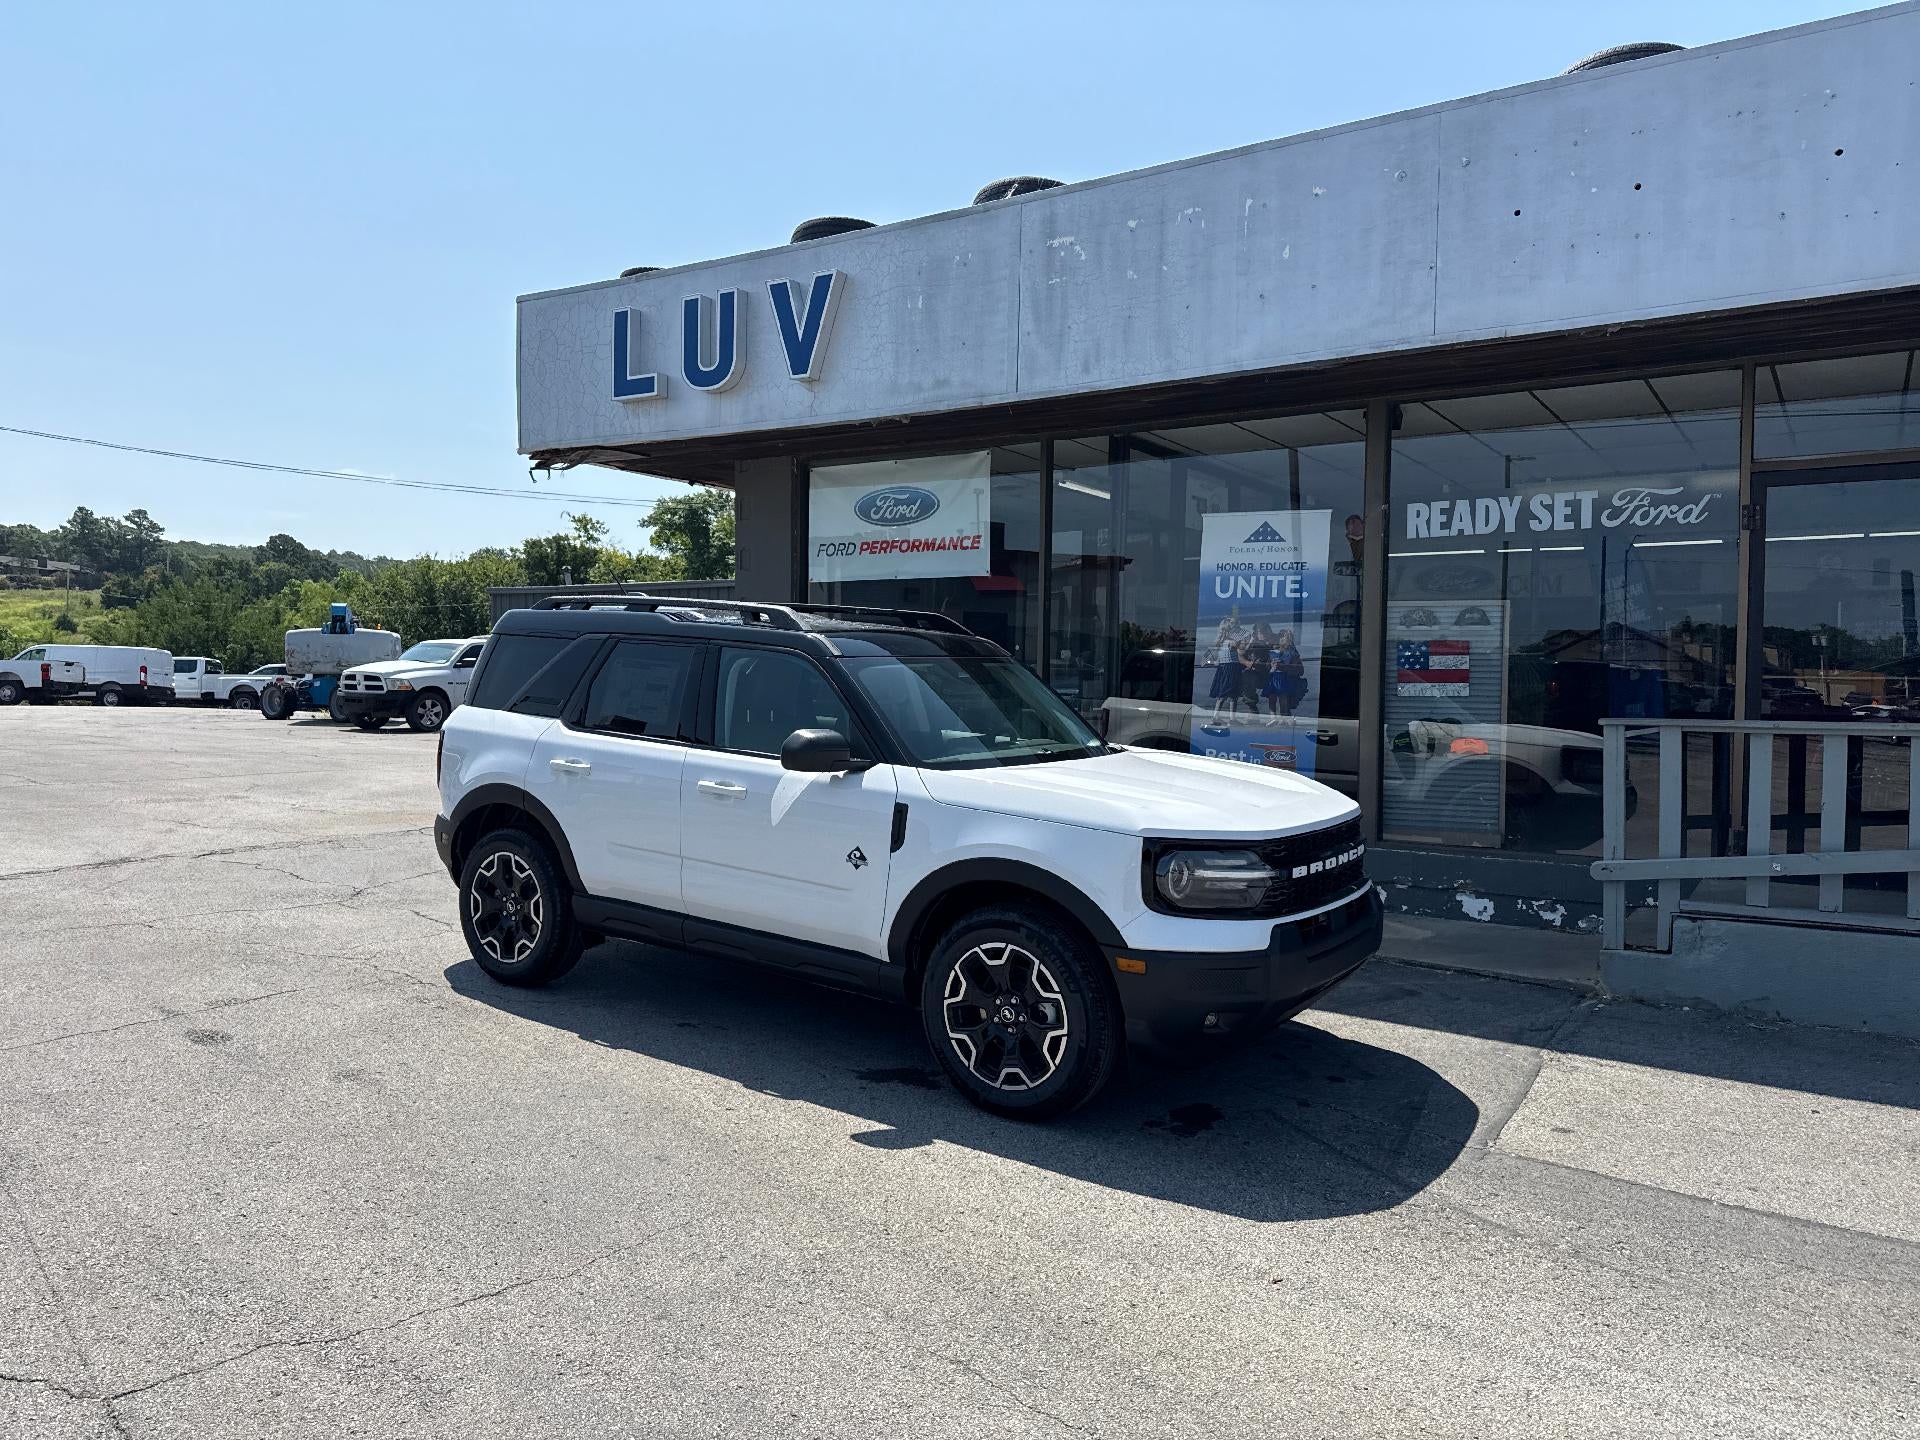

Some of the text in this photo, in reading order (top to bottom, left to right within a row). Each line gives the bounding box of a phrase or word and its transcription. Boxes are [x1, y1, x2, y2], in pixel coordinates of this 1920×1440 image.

[870, 492, 921, 520] Ford
[1406, 495, 1523, 540] READY
[1529, 490, 1599, 532] SET
[1600, 486, 1713, 528] Ford
[817, 534, 983, 558] FORD PERFORMANCE
[1266, 545, 1299, 553] HONOR
[1216, 561, 1310, 572] HONOR. EDUCATE.
[1215, 575, 1309, 599] UNITE.
[1292, 843, 1365, 879] BRONCO
